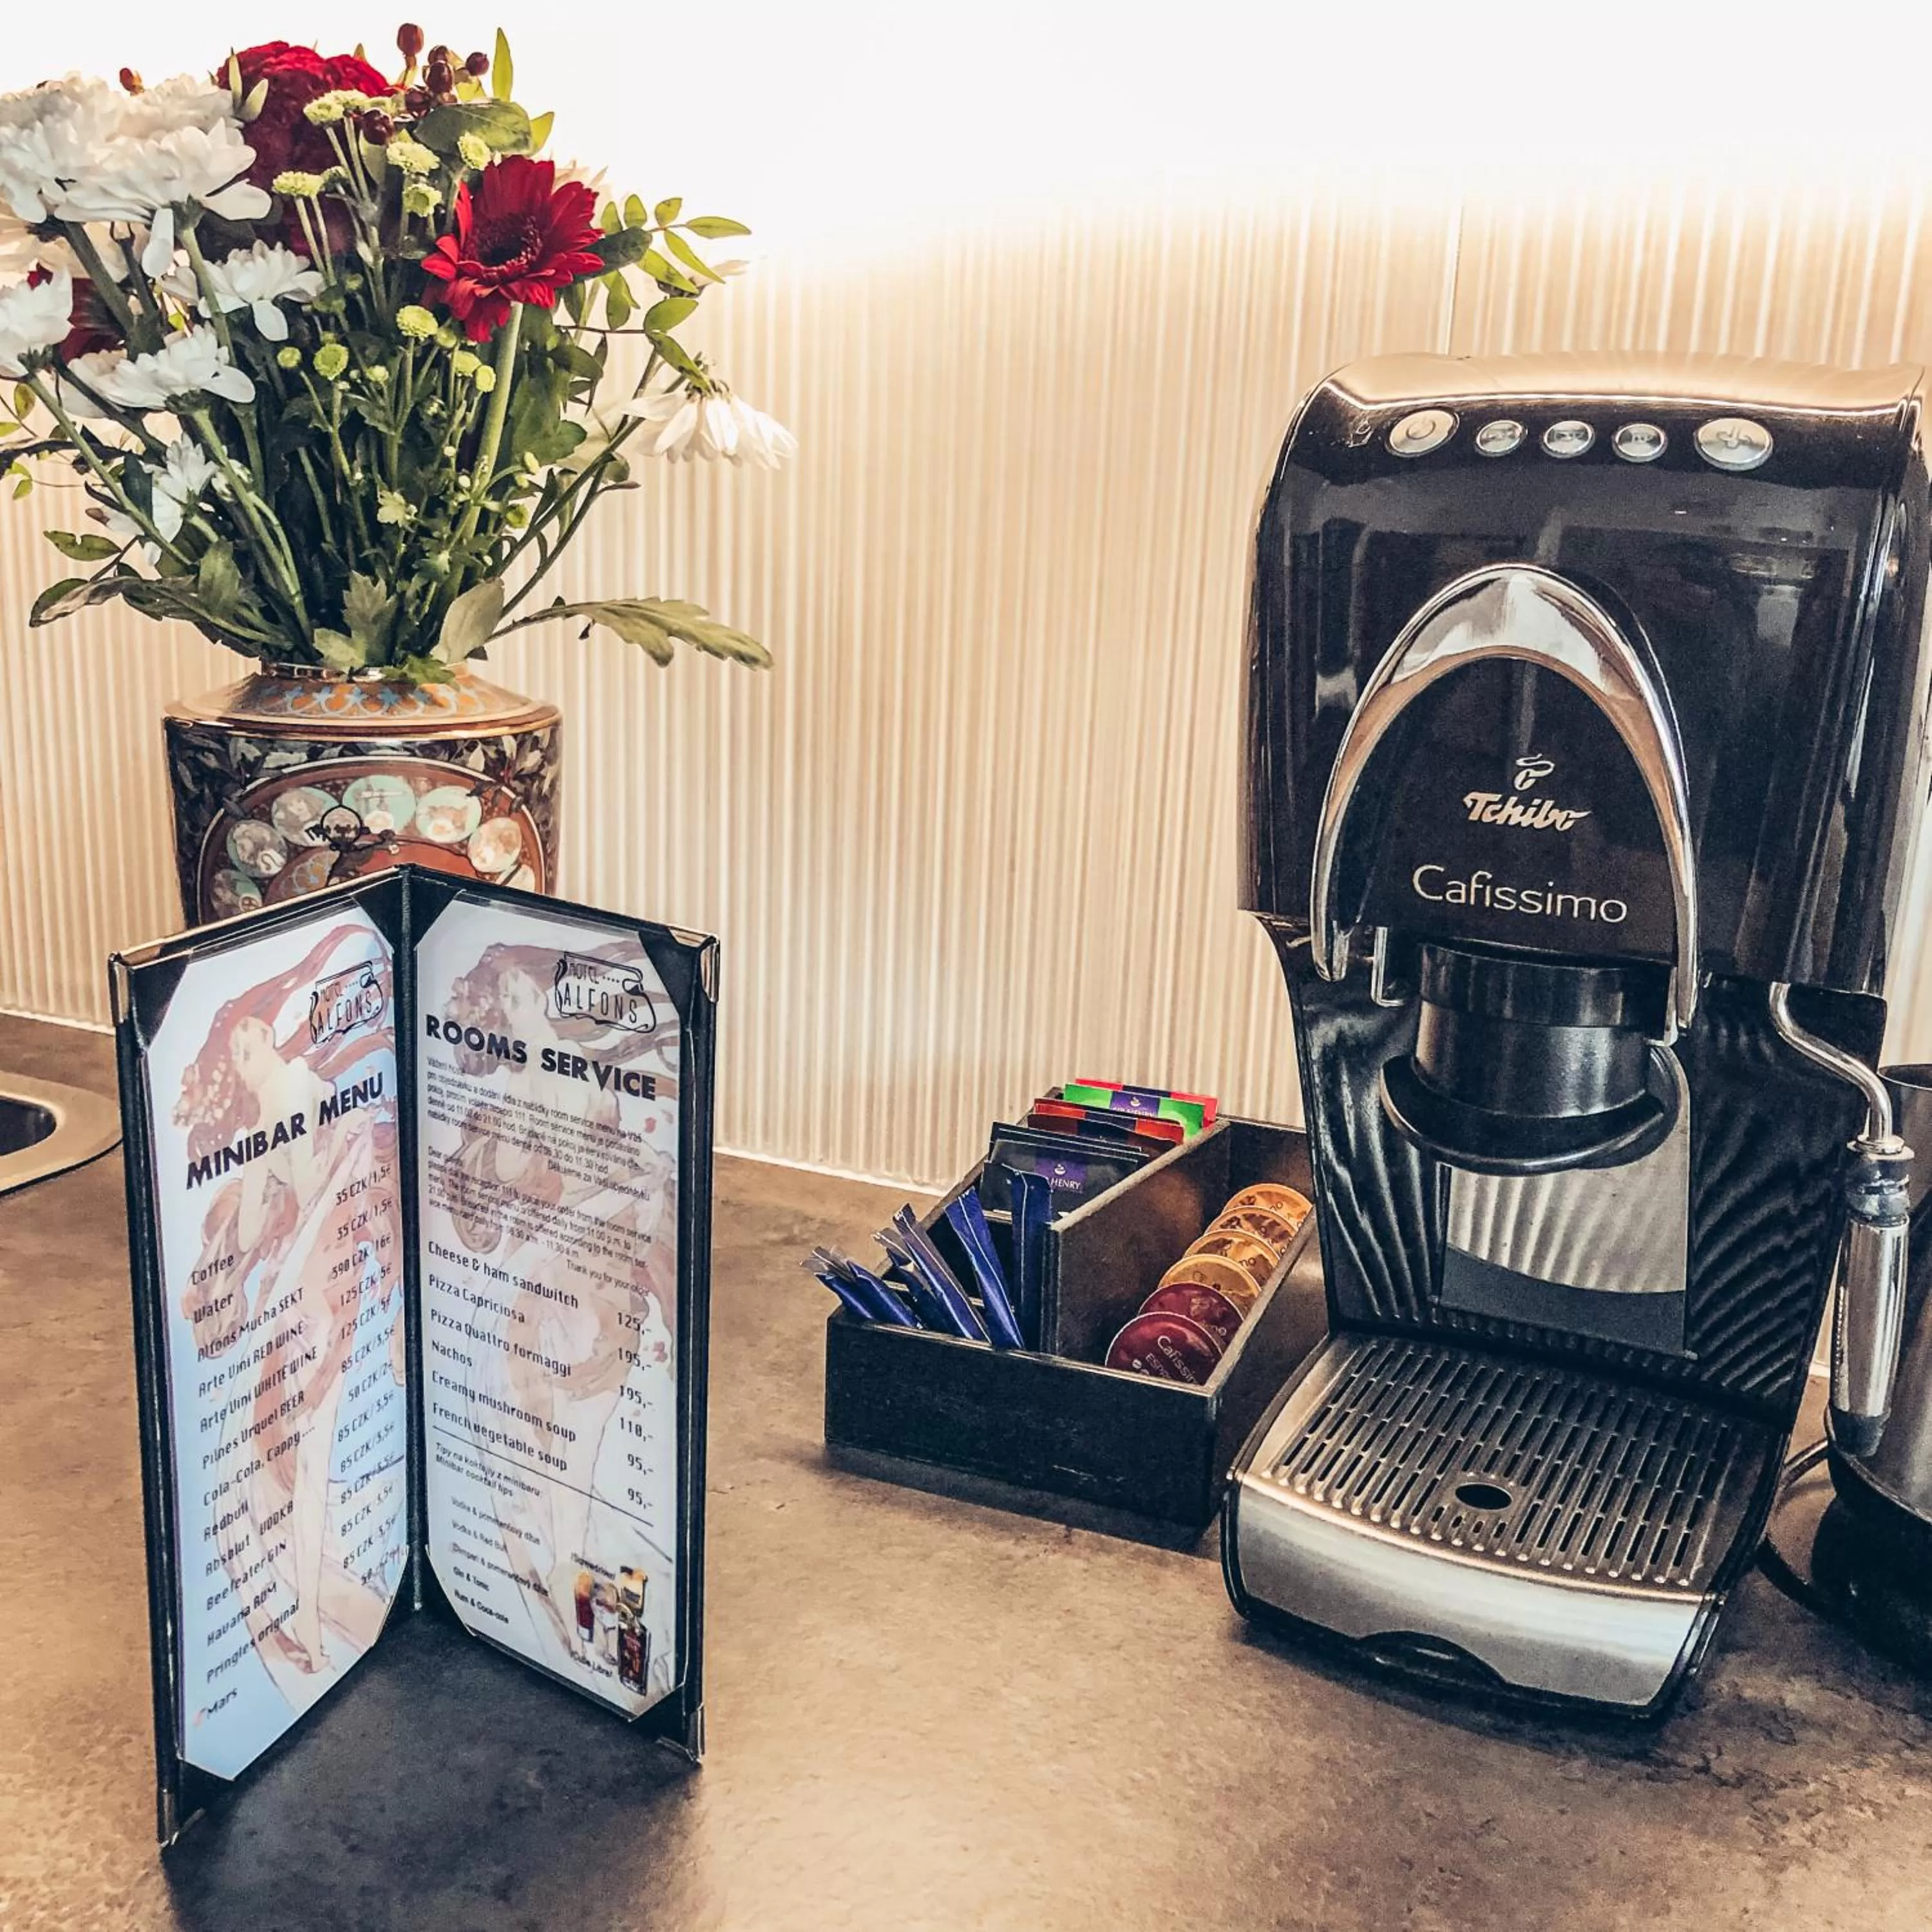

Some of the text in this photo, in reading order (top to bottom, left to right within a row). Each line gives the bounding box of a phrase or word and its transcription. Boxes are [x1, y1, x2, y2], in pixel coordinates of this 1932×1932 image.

[1463, 791, 1592, 830] Tchibo
[1412, 865, 1627, 922] Cafissimo
[317, 991, 372, 1034] ALFONS
[564, 981, 637, 1024] ALFONS
[426, 1016, 656, 1101] ROOMS SERVICE
[186, 1075, 383, 1189] MINIBAR MENU
[1050, 1177, 1081, 1189] HENRY
[191, 1253, 234, 1286] Coffee
[428, 1241, 578, 1309] Cheese & ham sandwitch
[193, 1291, 233, 1324] Water
[340, 1286, 357, 1306] 125
[429, 1274, 525, 1325] Pizza Capriciosa
[197, 1288, 304, 1363] Alfons Mucha SEKT
[341, 1318, 357, 1340] 125
[431, 1309, 571, 1379] Pizza Quattro formaggi
[198, 1370, 225, 1397] Arte
[253, 1341, 272, 1363] RED
[275, 1321, 303, 1349] WINE
[431, 1339, 472, 1367] Nachos
[200, 1405, 227, 1433] Arte
[254, 1366, 287, 1398] WHITE
[290, 1347, 317, 1375] WINE
[280, 1390, 305, 1417] BEER
[432, 1371, 576, 1444] Creamy mushroom soup
[433, 1402, 470, 1429] French
[538, 1449, 567, 1473] soup
[204, 1501, 249, 1542] Redbull
[259, 1501, 293, 1536] VODKA
[267, 1539, 286, 1564] GIN
[253, 1582, 276, 1610] RUM
[206, 1598, 299, 1686] Pringles original
[207, 1687, 237, 1719] Mars
